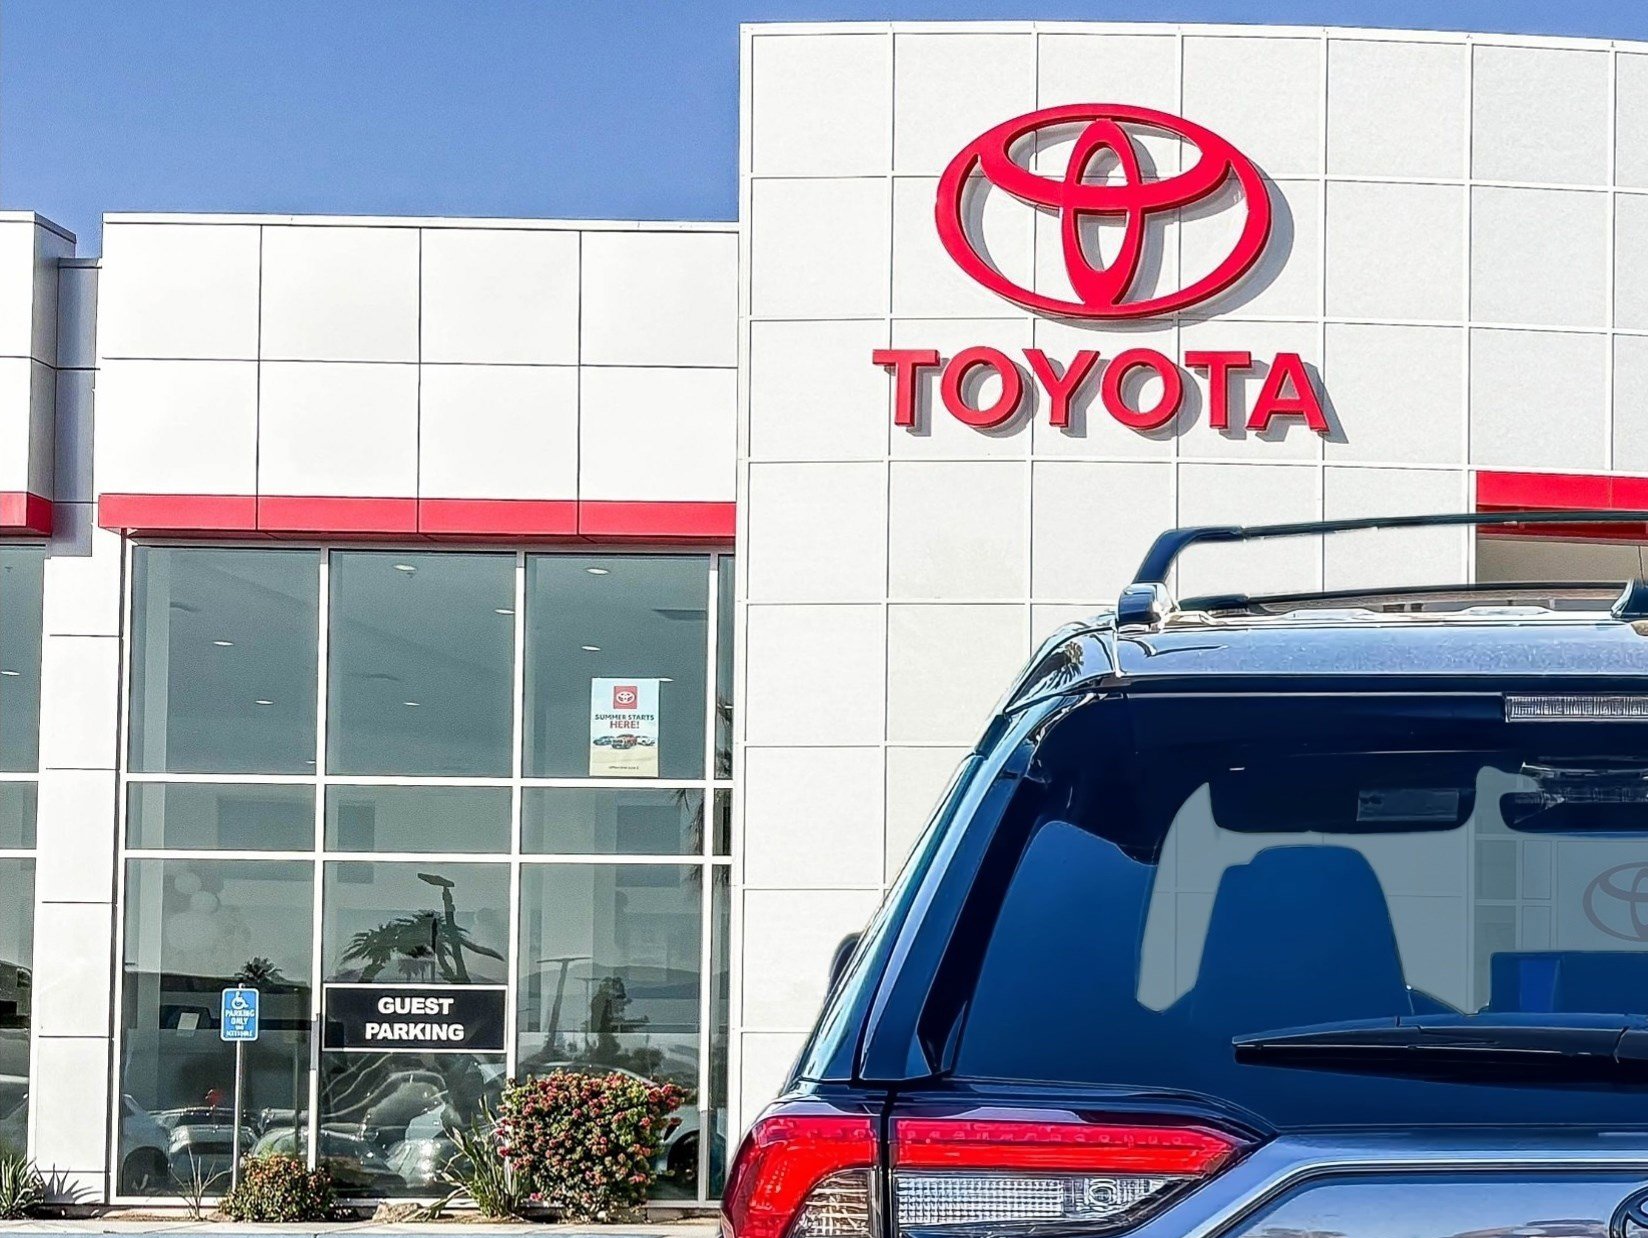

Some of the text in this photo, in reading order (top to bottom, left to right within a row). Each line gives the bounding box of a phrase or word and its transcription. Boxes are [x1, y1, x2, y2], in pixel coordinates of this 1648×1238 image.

[872, 345, 1330, 432] TOYOTA
[609, 720, 640, 729] HERE!
[377, 997, 455, 1015] GUEST
[365, 1023, 464, 1041] PARKING
